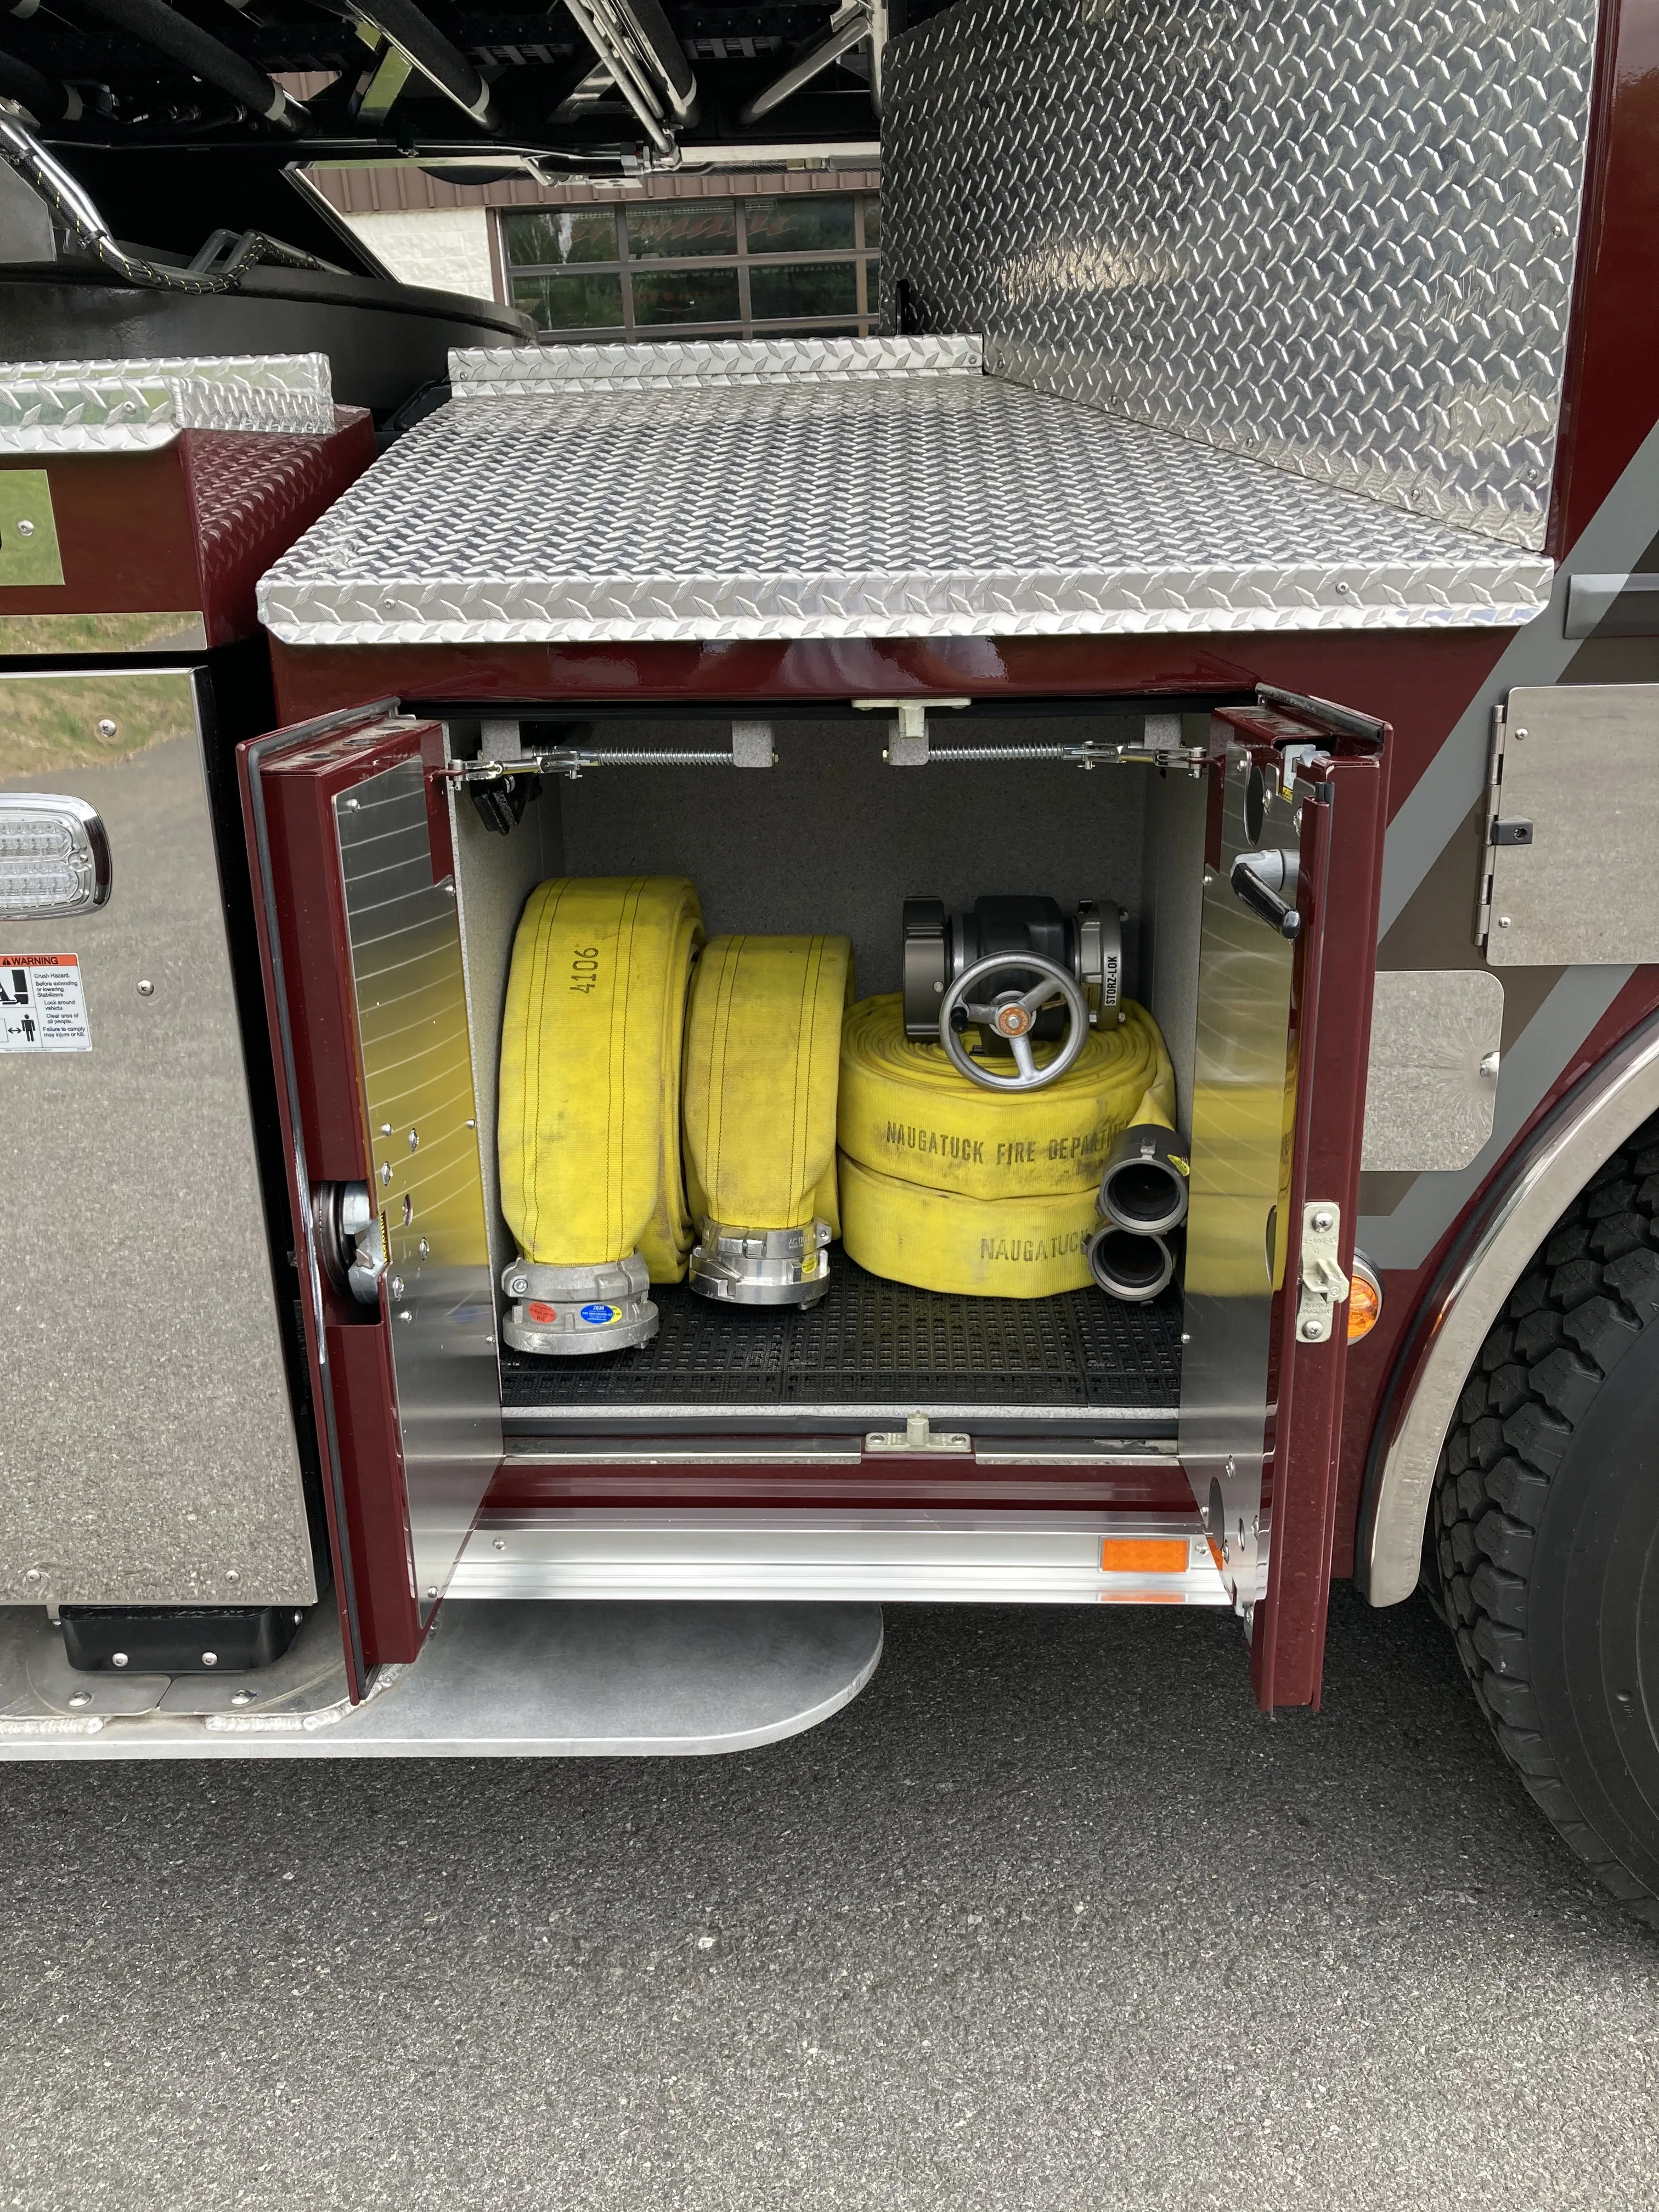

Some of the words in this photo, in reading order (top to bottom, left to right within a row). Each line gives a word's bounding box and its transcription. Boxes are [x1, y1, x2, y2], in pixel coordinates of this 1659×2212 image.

[11, 957, 58, 965] WARNING
[570, 947, 599, 994] 4106
[1105, 956, 1117, 1005] STORZ-LOK
[1000, 1014, 1011, 1033] CLOSED
[886, 1120, 984, 1164] NAUGATUCK
[996, 1141, 1036, 1166] FIRE
